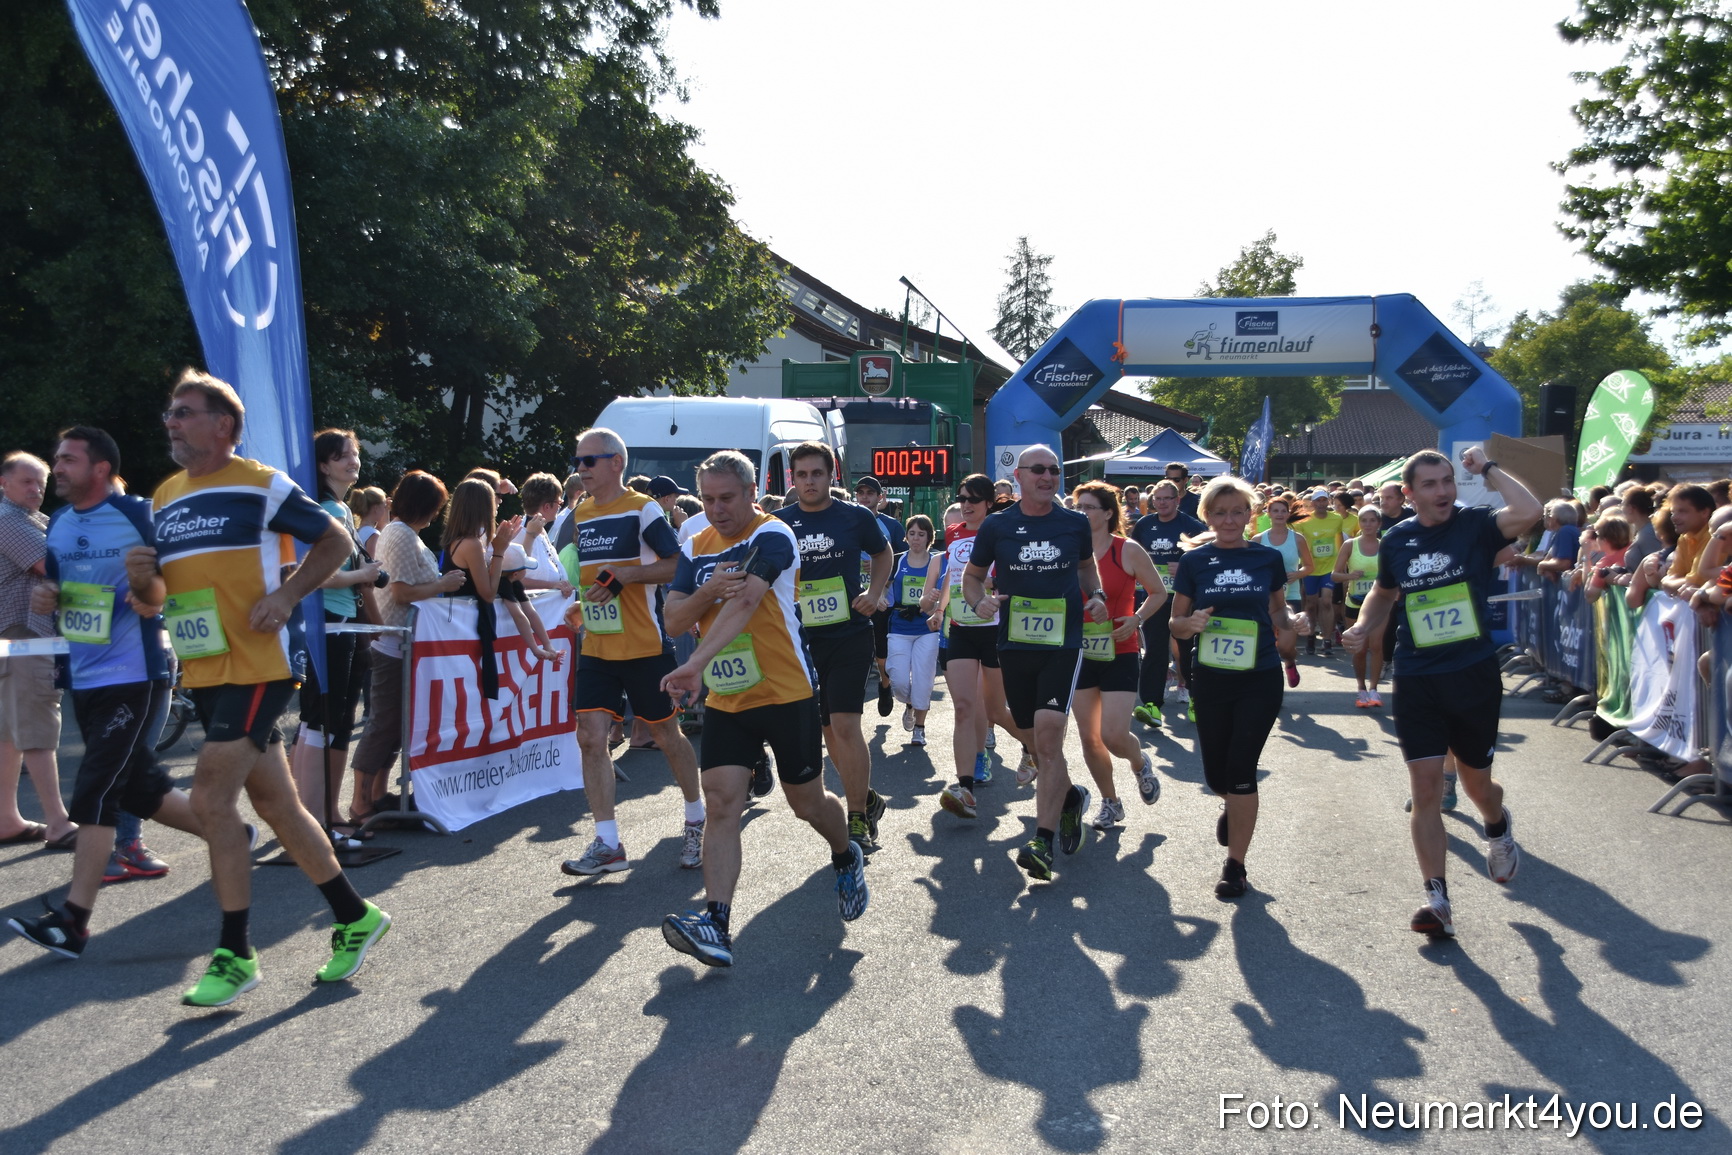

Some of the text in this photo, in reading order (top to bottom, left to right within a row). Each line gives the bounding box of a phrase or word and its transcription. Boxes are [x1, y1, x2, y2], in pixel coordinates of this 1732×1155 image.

[1220, 335, 1315, 354] firmenlauf
[1043, 371, 1093, 382] Fischer
[1580, 434, 1615, 471] AOK
[874, 450, 948, 477] 000247
[164, 515, 230, 537] Fischer
[169, 528, 223, 543] AUTOMOBILE
[580, 535, 618, 548] Fischer
[581, 545, 613, 553] AUTOMOBILE
[1316, 545, 1331, 553] 678
[1009, 563, 1033, 571] Weil's
[1036, 563, 1059, 572] guad
[1426, 570, 1451, 585] guad
[1452, 565, 1464, 576] is!
[1230, 585, 1251, 594] guad
[584, 603, 618, 620] 1519
[807, 596, 838, 614] 189
[65, 610, 102, 633] 6091
[1021, 616, 1054, 631] 170
[1422, 608, 1463, 631] 172
[176, 617, 210, 641] 406
[1211, 638, 1245, 656] 175
[711, 657, 747, 679] 403
